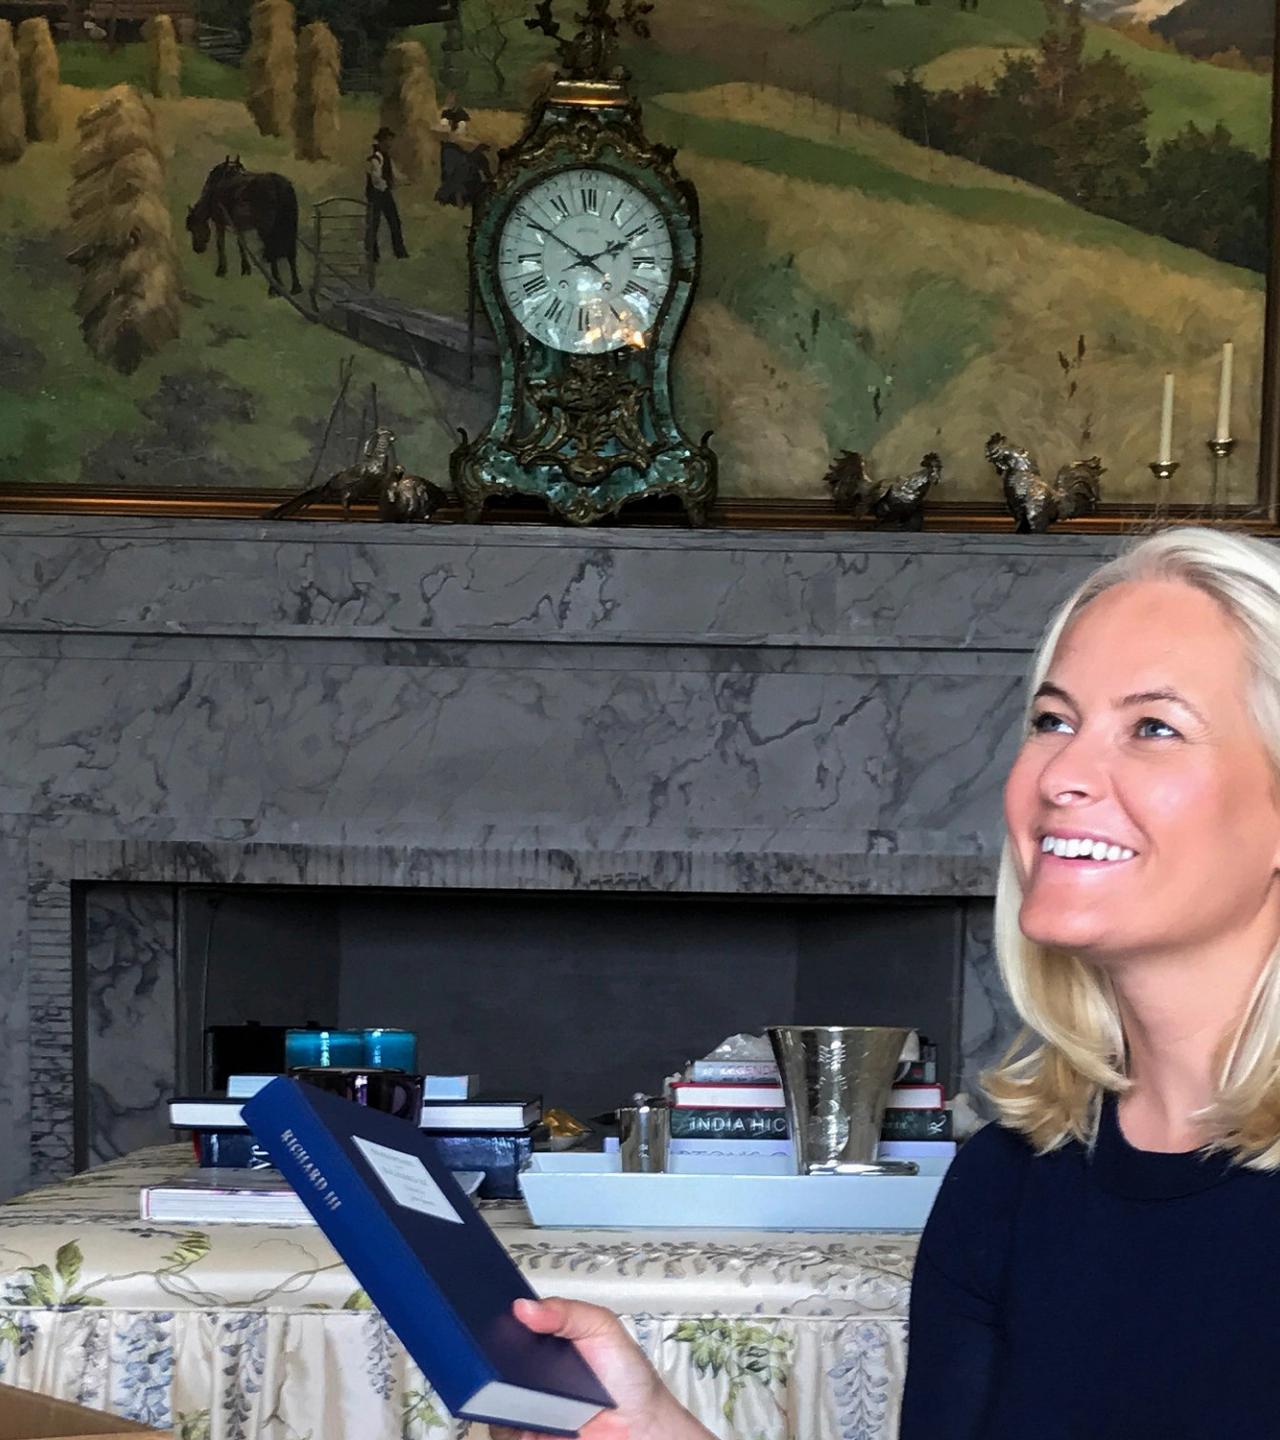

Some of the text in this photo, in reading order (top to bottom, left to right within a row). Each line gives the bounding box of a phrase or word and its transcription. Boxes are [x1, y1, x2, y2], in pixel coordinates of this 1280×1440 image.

[689, 1117, 746, 1131] INDIA
[280, 1128, 343, 1211] RICHARD III
